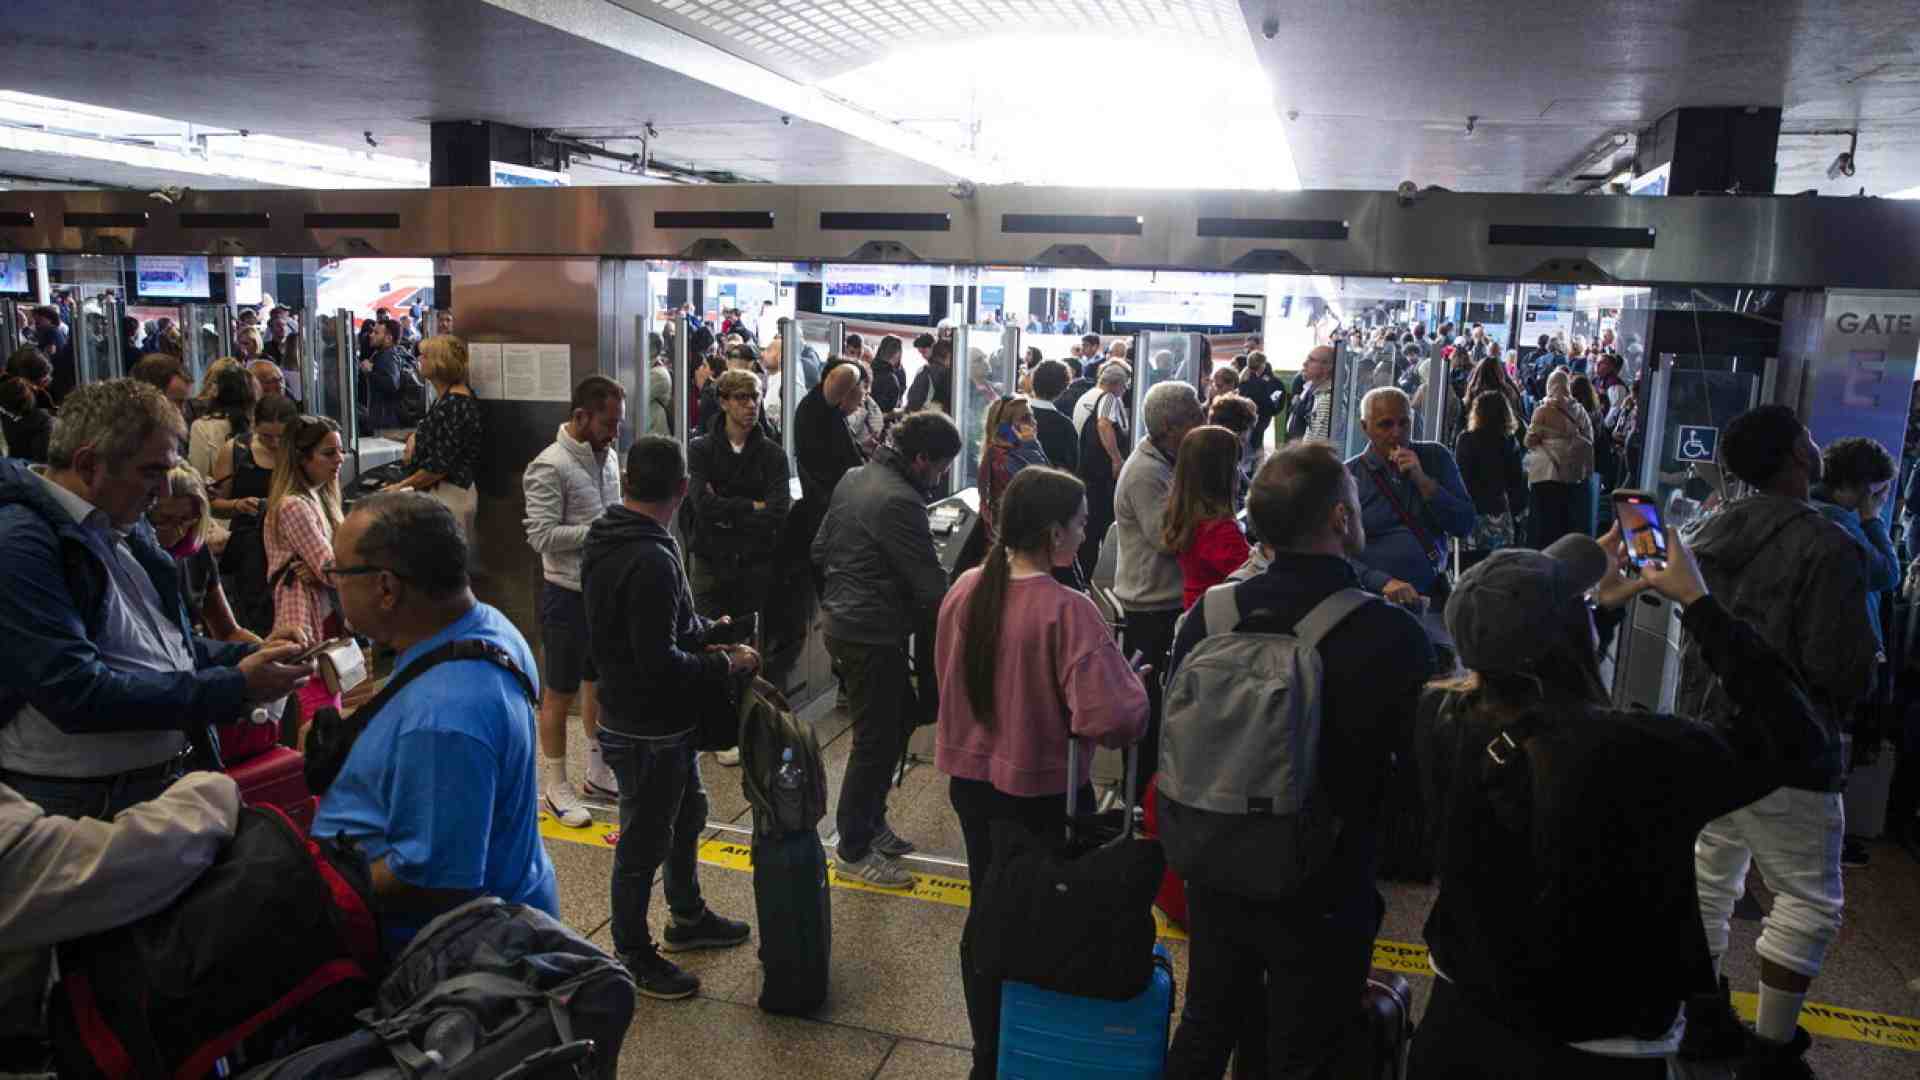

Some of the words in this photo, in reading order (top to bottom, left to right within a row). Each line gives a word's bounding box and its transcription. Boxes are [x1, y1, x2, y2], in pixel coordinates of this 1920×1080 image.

[1837, 312, 1912, 335] GATE
[1842, 349, 1886, 408] E
[1800, 1006, 1920, 1033] Attender
